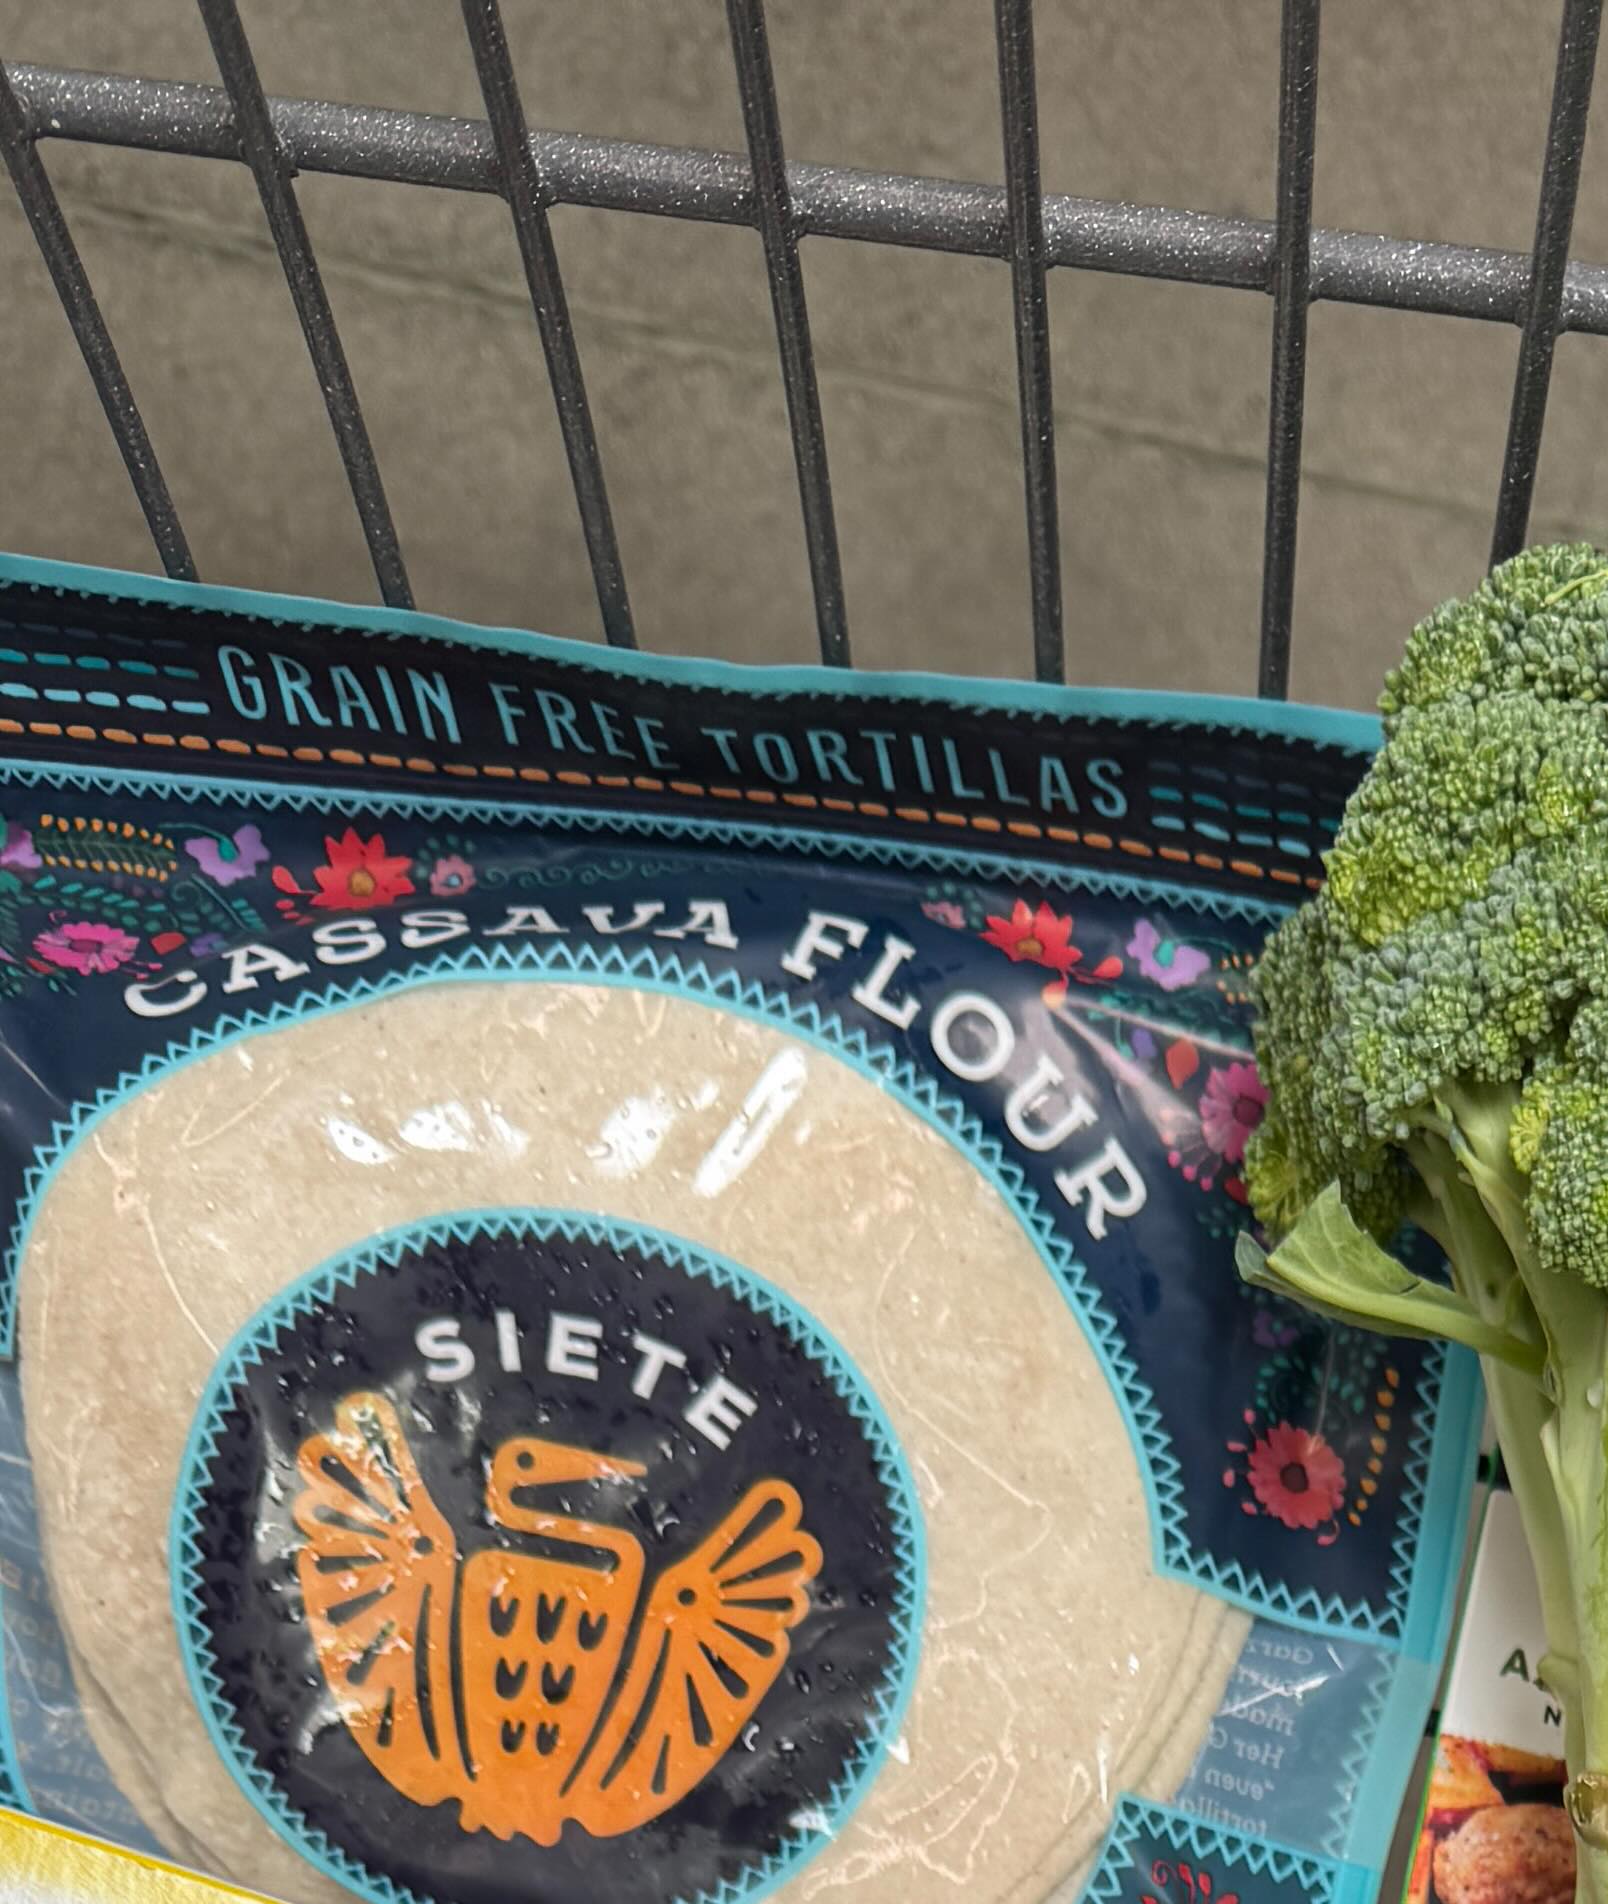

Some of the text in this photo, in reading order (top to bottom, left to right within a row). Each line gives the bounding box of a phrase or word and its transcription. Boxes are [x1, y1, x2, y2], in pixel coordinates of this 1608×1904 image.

[217, 643, 1128, 818] GRAIN FREE TORTILLAS
[124, 900, 1148, 1241] CASSAVA FLOUR
[413, 1309, 759, 1452] SIETE
